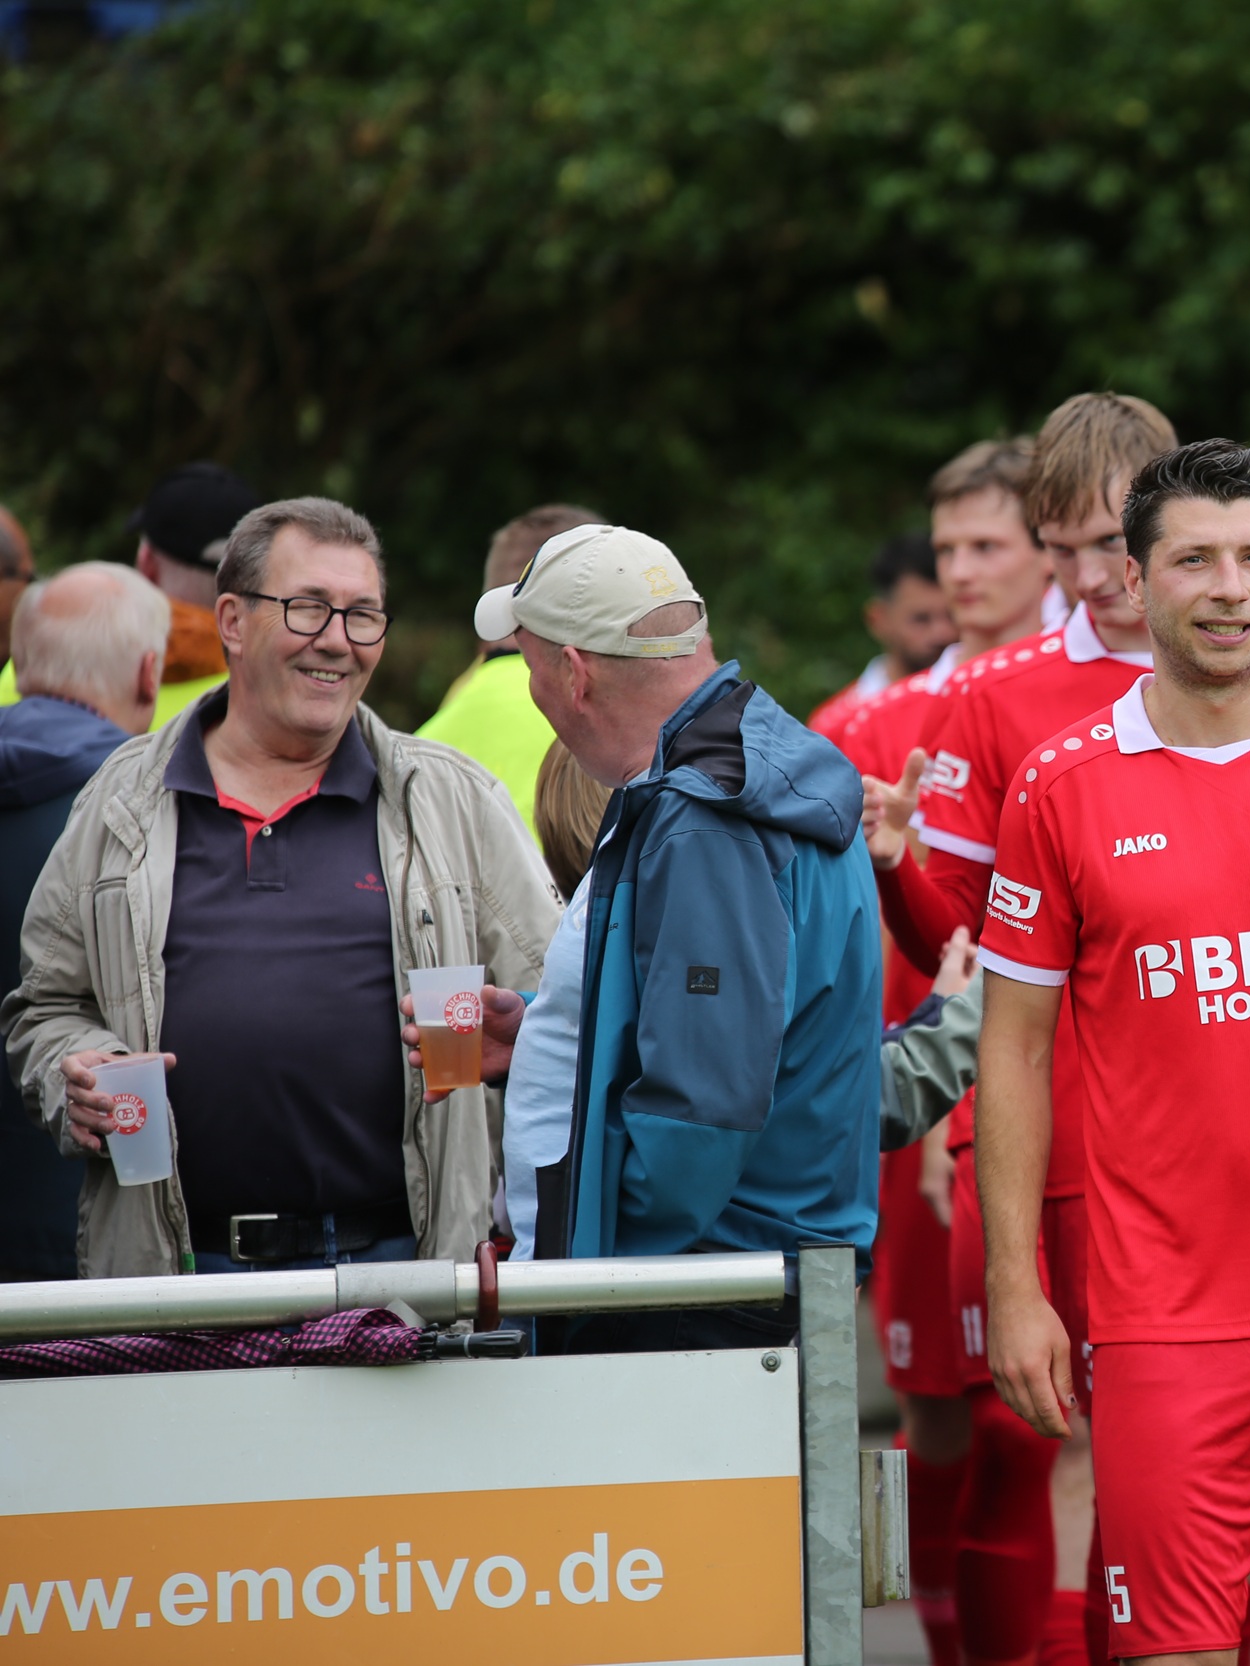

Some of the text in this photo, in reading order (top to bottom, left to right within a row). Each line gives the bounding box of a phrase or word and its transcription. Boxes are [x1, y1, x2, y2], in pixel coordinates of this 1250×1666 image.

[1112, 832, 1168, 858] JAKO
[445, 1015, 458, 1032] TSV
[1104, 1565, 1132, 1624] 5
